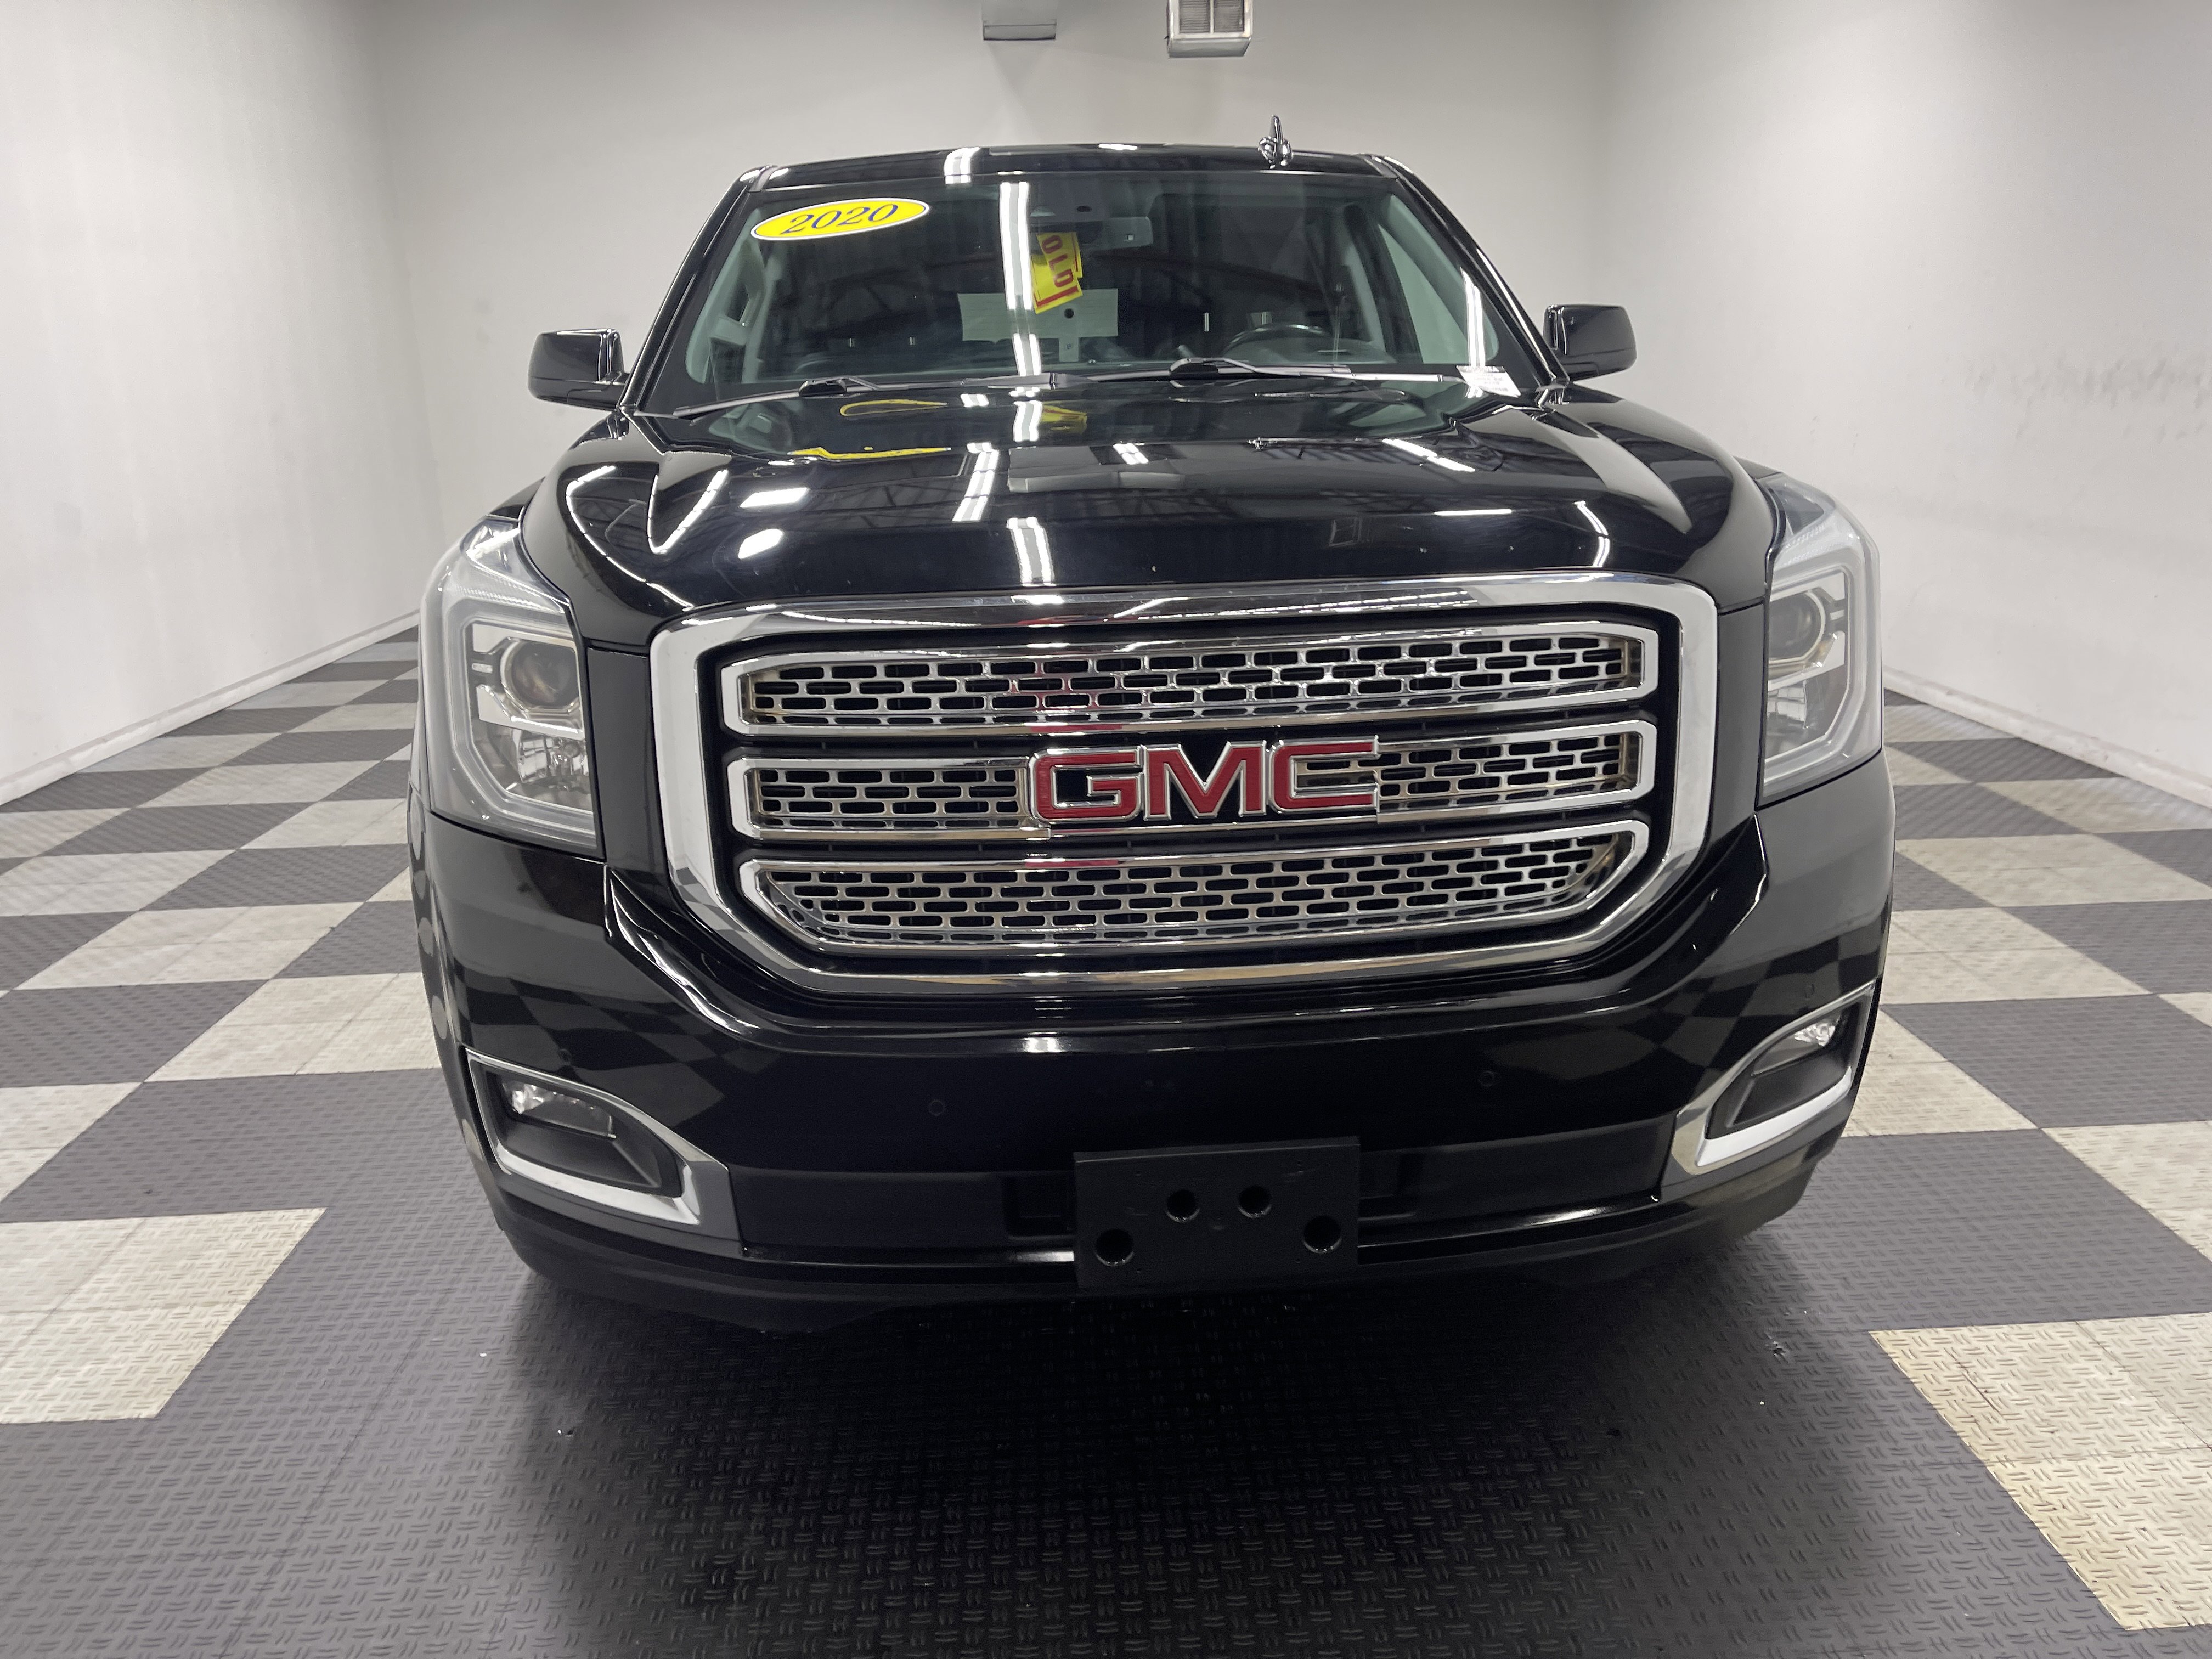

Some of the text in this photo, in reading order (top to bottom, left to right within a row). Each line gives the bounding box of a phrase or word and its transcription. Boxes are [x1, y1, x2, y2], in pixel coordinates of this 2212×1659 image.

[779, 204, 899, 235] 2020
[1041, 235, 1074, 288] OLD
[1028, 735, 1380, 823] GMC
